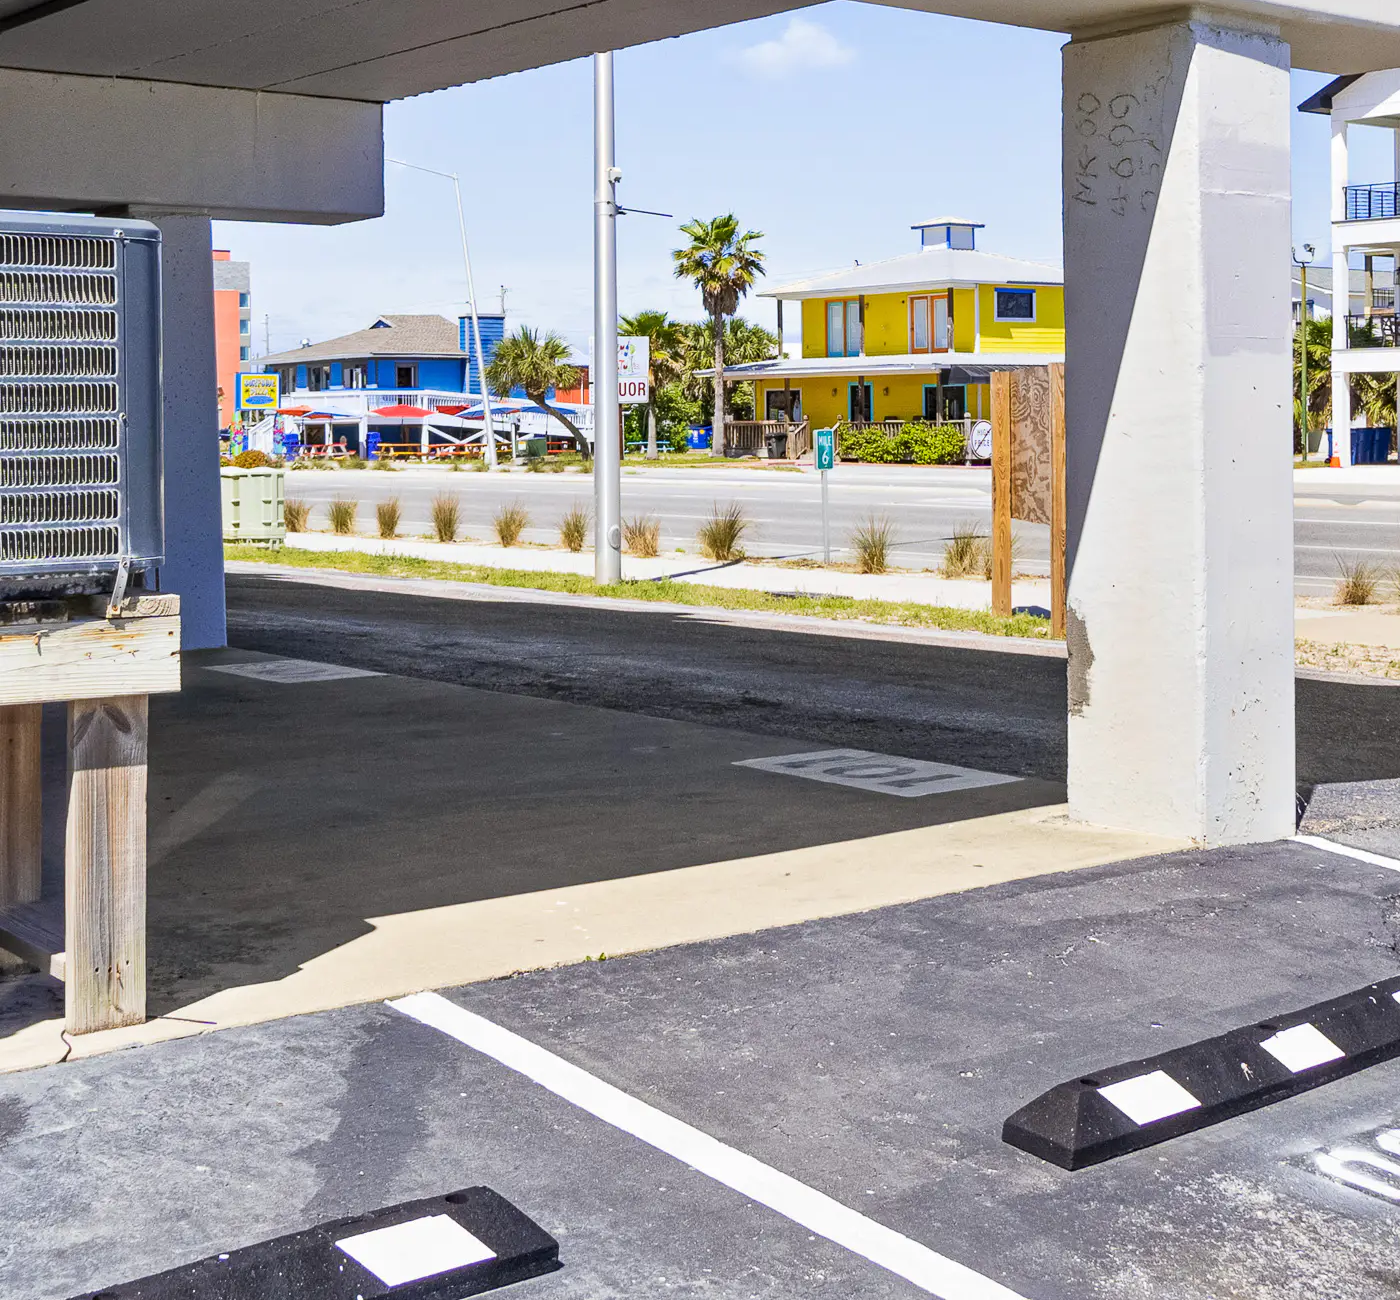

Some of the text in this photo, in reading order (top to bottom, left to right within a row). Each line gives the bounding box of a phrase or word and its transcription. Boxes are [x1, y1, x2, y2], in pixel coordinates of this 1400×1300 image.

[618, 381, 646, 397] UOR
[818, 435, 832, 447] MILE
[821, 447, 830, 465] 6
